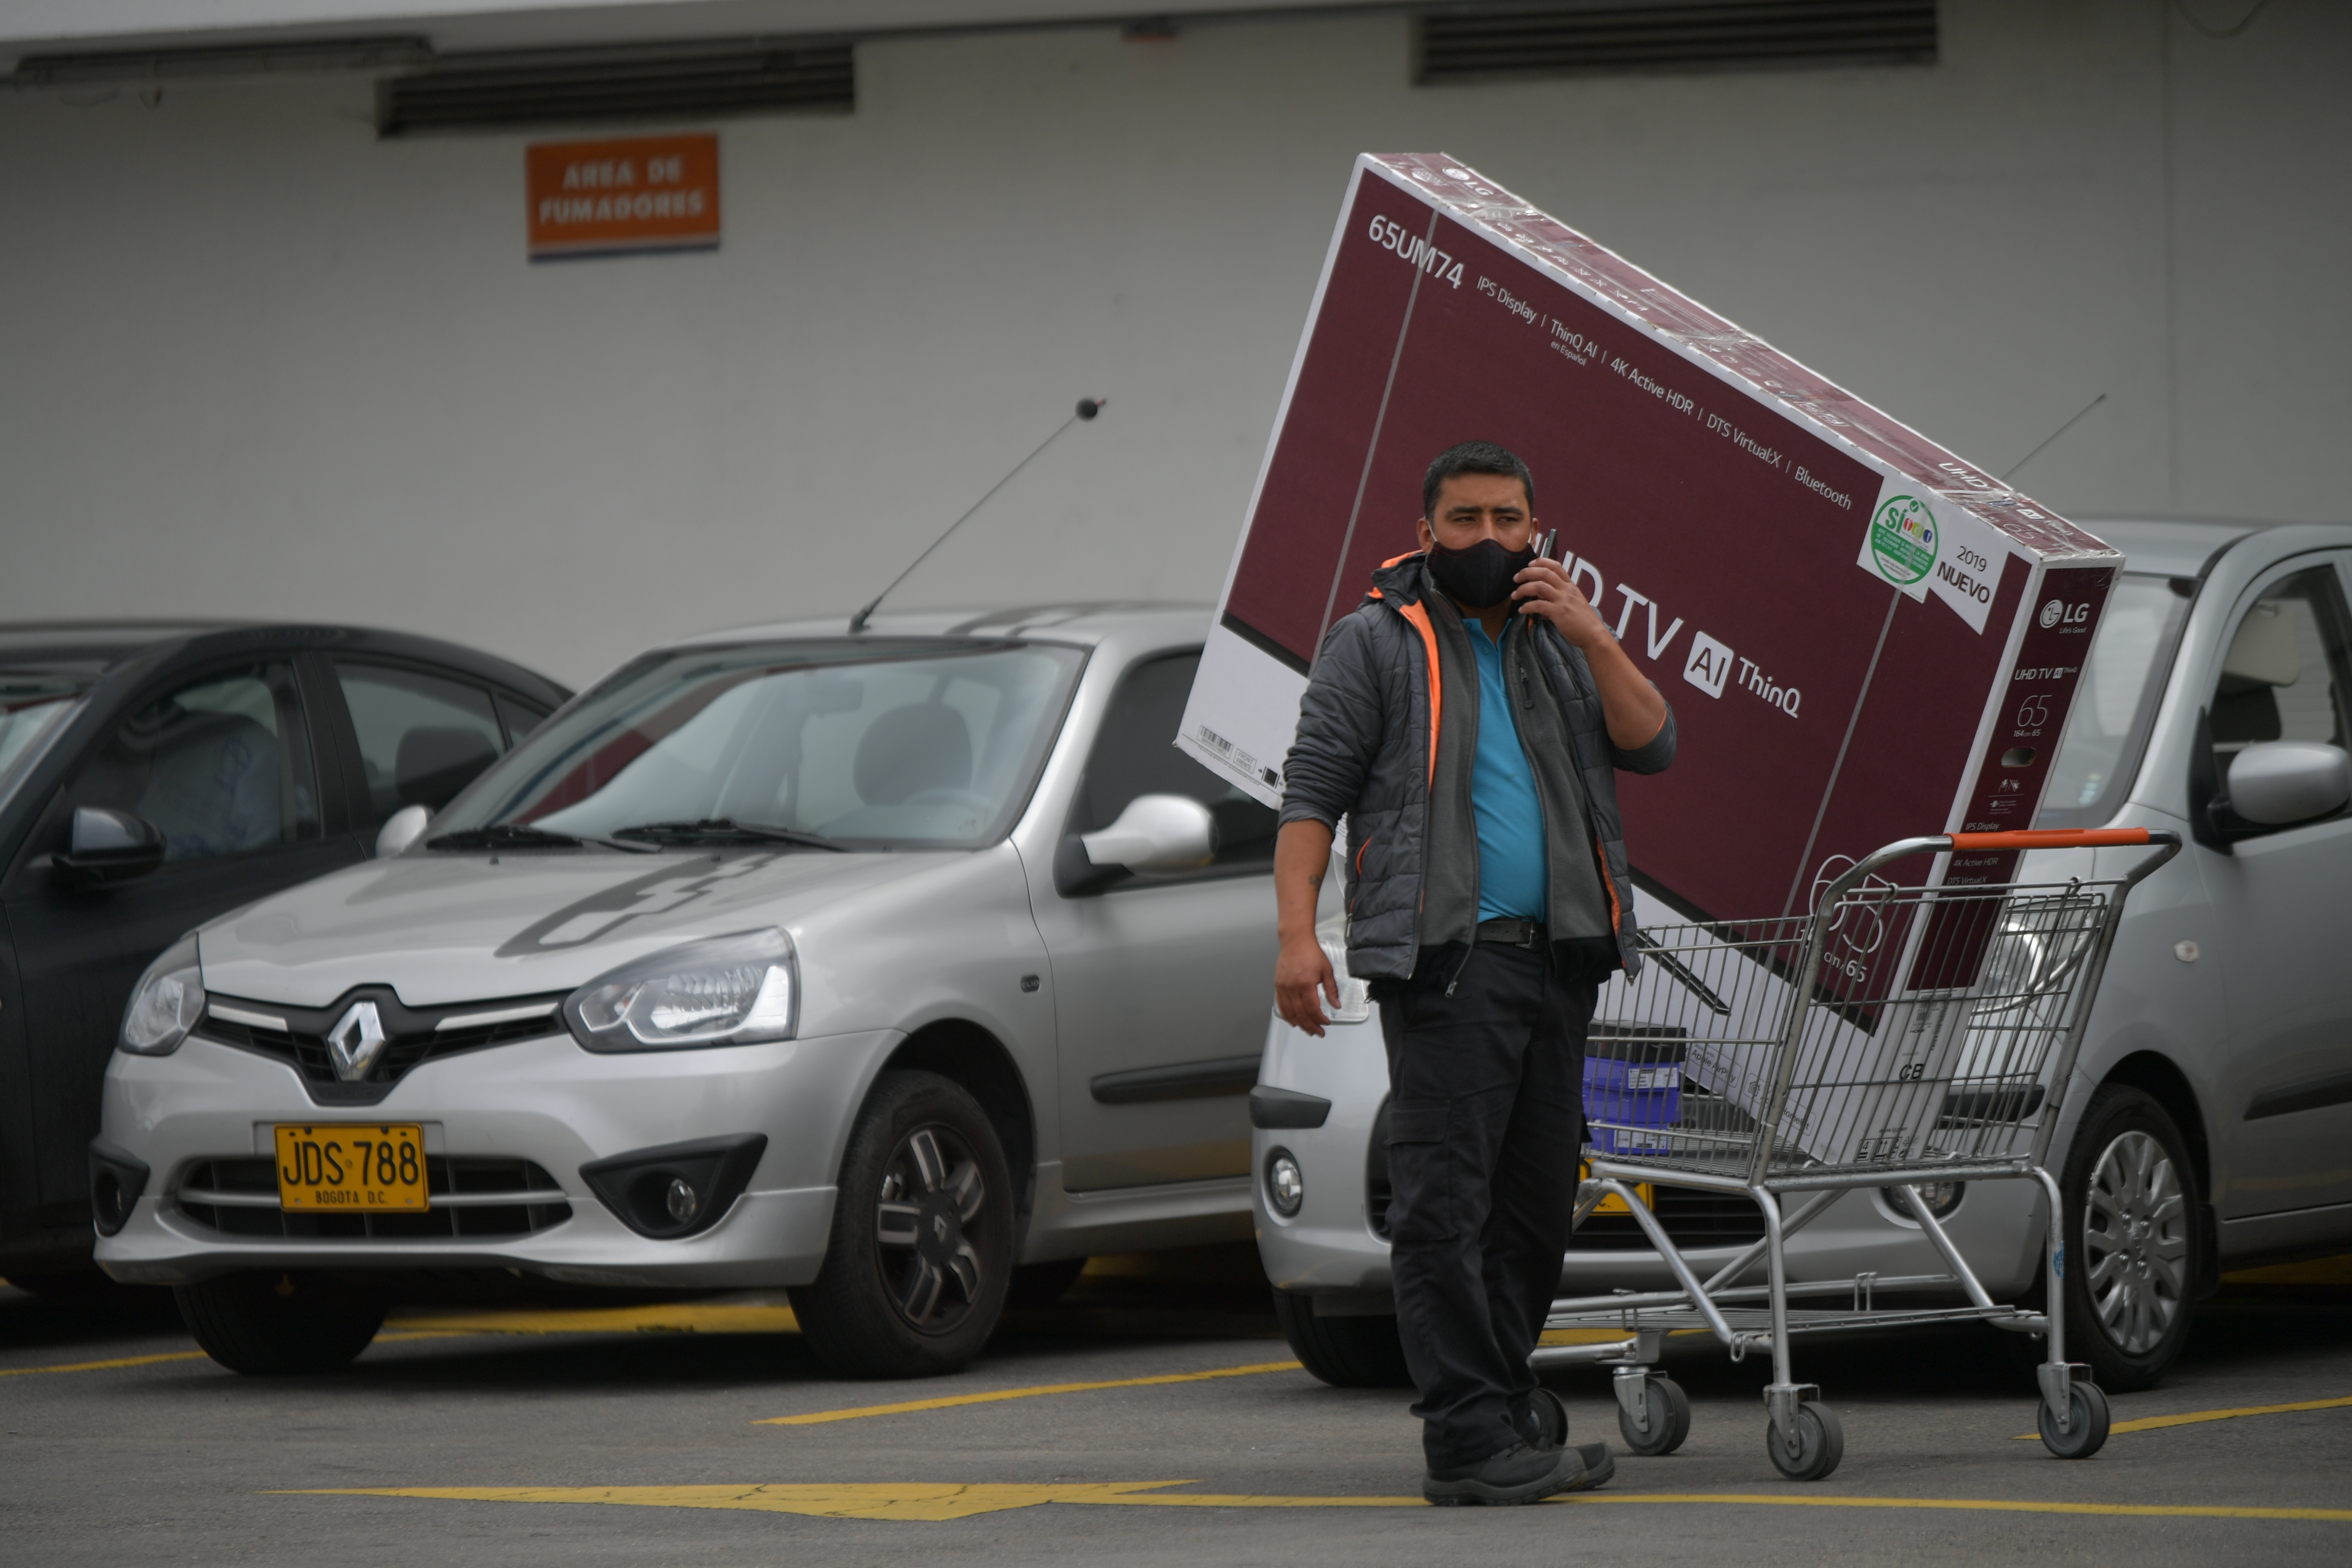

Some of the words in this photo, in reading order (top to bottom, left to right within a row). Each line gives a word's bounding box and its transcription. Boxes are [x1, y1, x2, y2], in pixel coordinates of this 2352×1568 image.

[562, 160, 633, 190] AREA
[647, 155, 683, 183] DE
[1464, 182, 1493, 195] LG
[539, 190, 704, 225] FUMADORES
[1368, 215, 1465, 289] 65UM74
[1551, 341, 1560, 350] en
[1560, 345, 1586, 366] Español
[1476, 275, 1497, 297] IPS
[1497, 288, 1537, 324] Display
[1551, 319, 1583, 351] ThinQ
[1583, 341, 1597, 358] AI
[1611, 358, 1629, 376] 4K
[1628, 368, 1664, 398] Active
[1666, 389, 1693, 415] HDR
[1707, 414, 1731, 437] DTS
[1734, 428, 1782, 468] Virtual:X
[1795, 466, 1851, 510] Bluetooth
[1938, 463, 1987, 487] UHD
[2004, 524, 2034, 539] 65
[1957, 546, 1987, 572] 2019
[1937, 561, 1990, 604] NUEVO
[2063, 603, 2090, 623] LG
[1616, 583, 1684, 661] TV
[1689, 647, 1726, 687] AI
[1738, 656, 1800, 719] ThinQ
[2014, 669, 2037, 680] UHD
[2038, 668, 2053, 679] TV
[2017, 695, 2053, 727] 65
[1236, 758, 1251, 770] FRENTE
[1238, 752, 1253, 764] FRONT
[1977, 822, 1999, 832] Display
[1983, 857, 1998, 866] HDR
[1947, 877, 1960, 885] DTS
[1809, 855, 1882, 954] 65
[283, 1141, 344, 1185] JDS
[353, 1141, 419, 1185] 788
[316, 1191, 359, 1203] BOGOTA
[368, 1191, 387, 1204] D.C.
